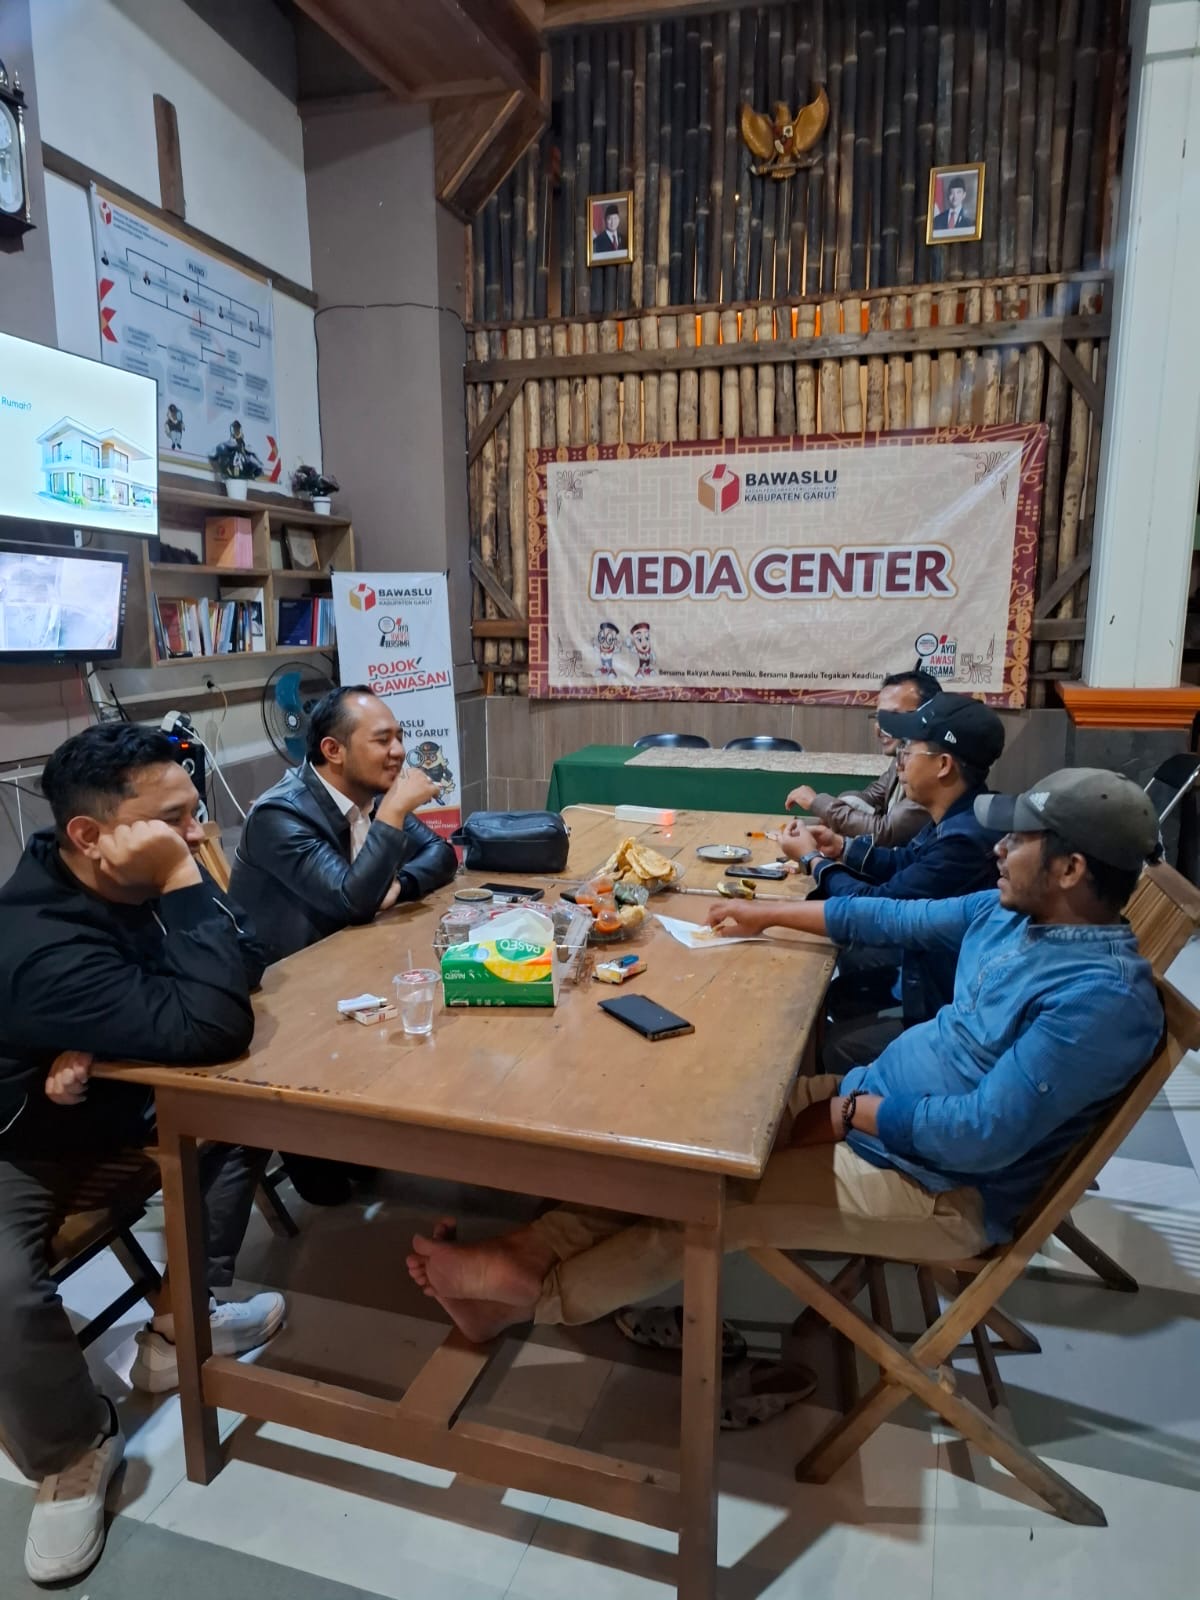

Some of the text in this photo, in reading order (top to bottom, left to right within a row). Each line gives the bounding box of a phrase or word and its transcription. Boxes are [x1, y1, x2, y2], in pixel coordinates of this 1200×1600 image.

[1, 396, 32, 410] Rumah?
[745, 469, 838, 487] BAWASLU
[744, 490, 836, 502] KABUPATEN GARUT
[594, 550, 951, 595] MEDIA CENTER
[378, 588, 432, 597] BAWASLU
[940, 644, 956, 654] AYO
[930, 656, 954, 665] AWASI
[368, 658, 418, 677] POJOK
[659, 669, 685, 677] Bersama
[686, 670, 709, 678] Rakyat
[759, 670, 787, 678] Bersama
[789, 671, 818, 679] Bawaslu
[820, 671, 850, 680] Tegakan
[851, 671, 884, 680] Keadilan
[399, 719, 424, 728] ASLU
[415, 729, 448, 738] GARUT
[500, 939, 541, 954] PASEO
